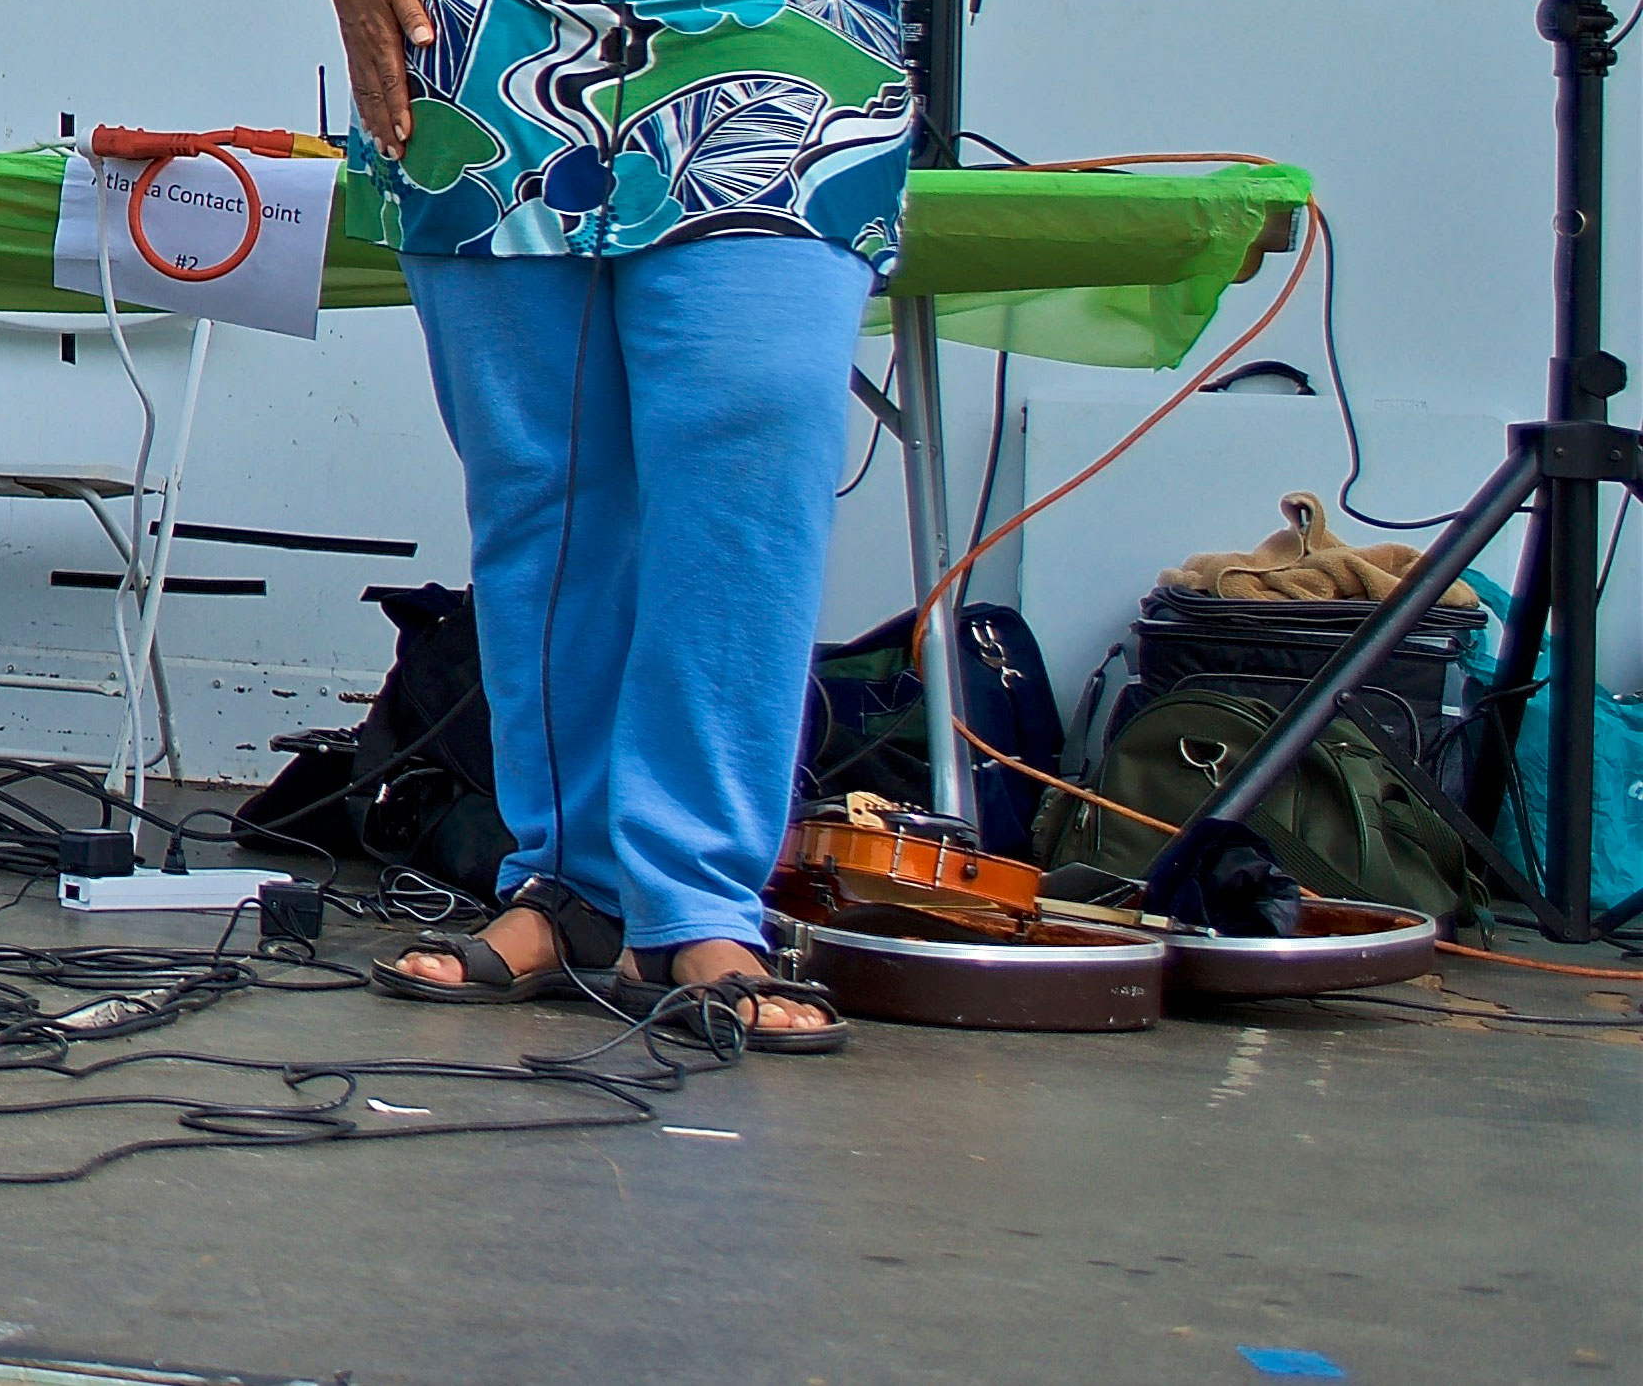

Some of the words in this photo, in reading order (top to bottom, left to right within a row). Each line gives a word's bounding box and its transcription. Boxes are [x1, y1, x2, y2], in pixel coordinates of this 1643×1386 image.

[168, 184, 244, 214] Contact
[261, 203, 302, 224] oint
[174, 254, 199, 271] #2
